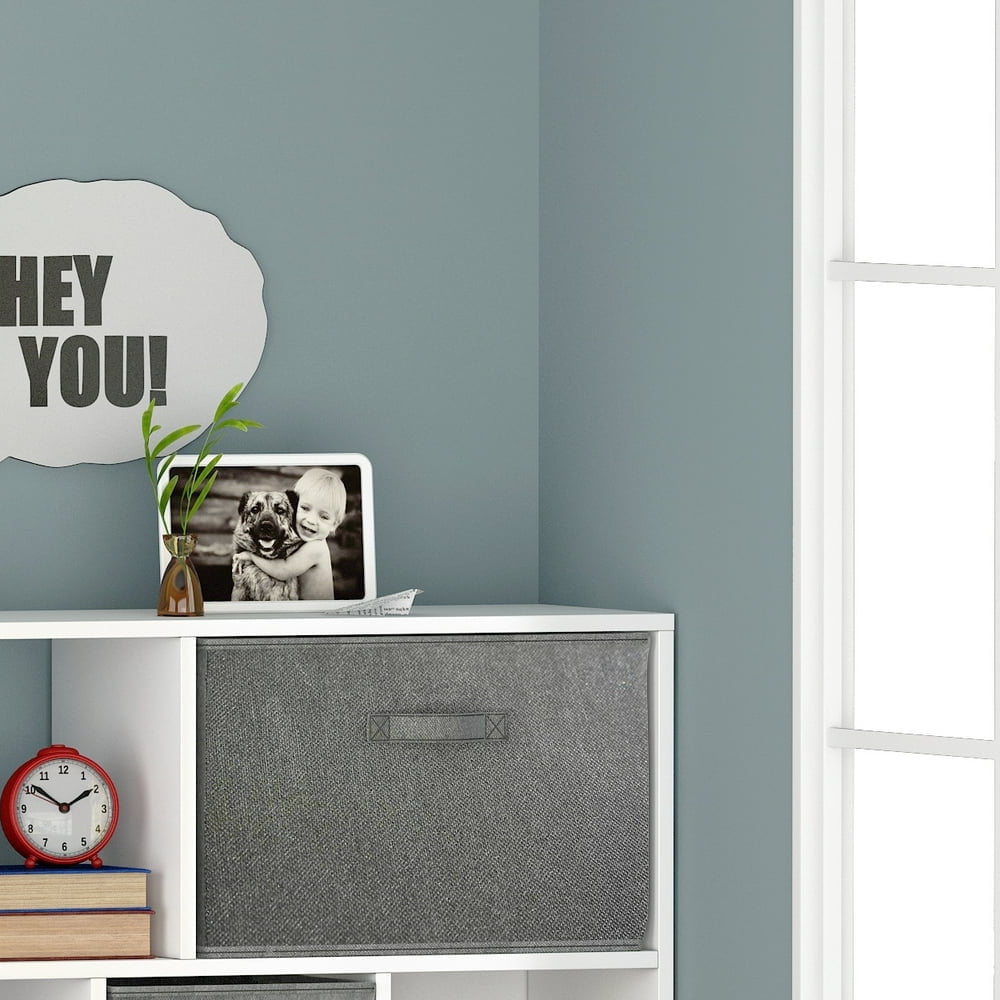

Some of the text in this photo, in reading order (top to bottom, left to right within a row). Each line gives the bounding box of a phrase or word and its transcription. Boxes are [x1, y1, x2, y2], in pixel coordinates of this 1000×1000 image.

[18, 335, 168, 408] YOU!
[58, 765, 69, 775] 12
[39, 771, 50, 781] 11
[81, 771, 87, 781] 1
[25, 785, 36, 795] 10
[93, 784, 99, 794] 2
[21, 804, 27, 814] 9
[101, 804, 107, 814] 3
[27, 824, 34, 834] 8
[95, 824, 101, 833] 4
[42, 838, 48, 847] 7
[61, 842, 68, 851] 6
[81, 837, 87, 847] 5
